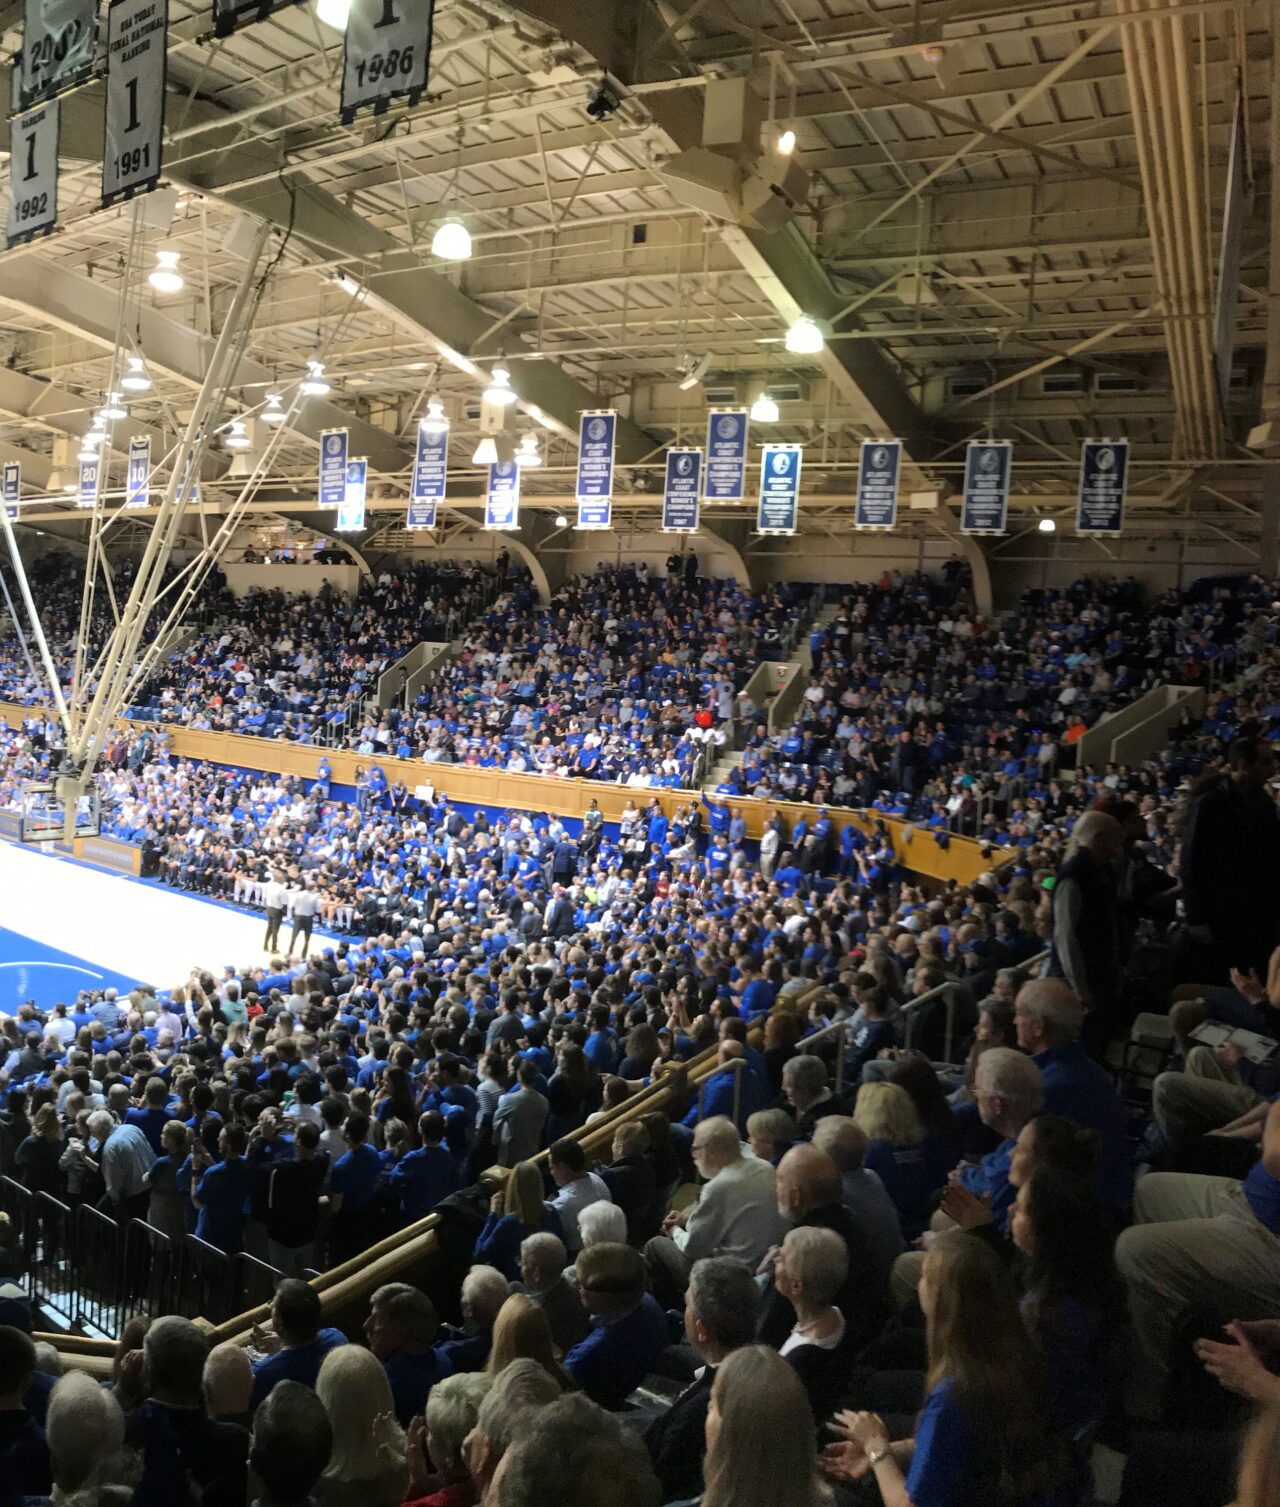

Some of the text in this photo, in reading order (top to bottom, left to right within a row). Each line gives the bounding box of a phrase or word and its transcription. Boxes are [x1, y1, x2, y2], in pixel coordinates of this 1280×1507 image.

[355, 45, 415, 88] 1986
[125, 76, 141, 133] 1
[22, 131, 39, 181] 1
[114, 142, 149, 179] 1991
[15, 192, 48, 223] 1992
[83, 467, 97, 482] 20
